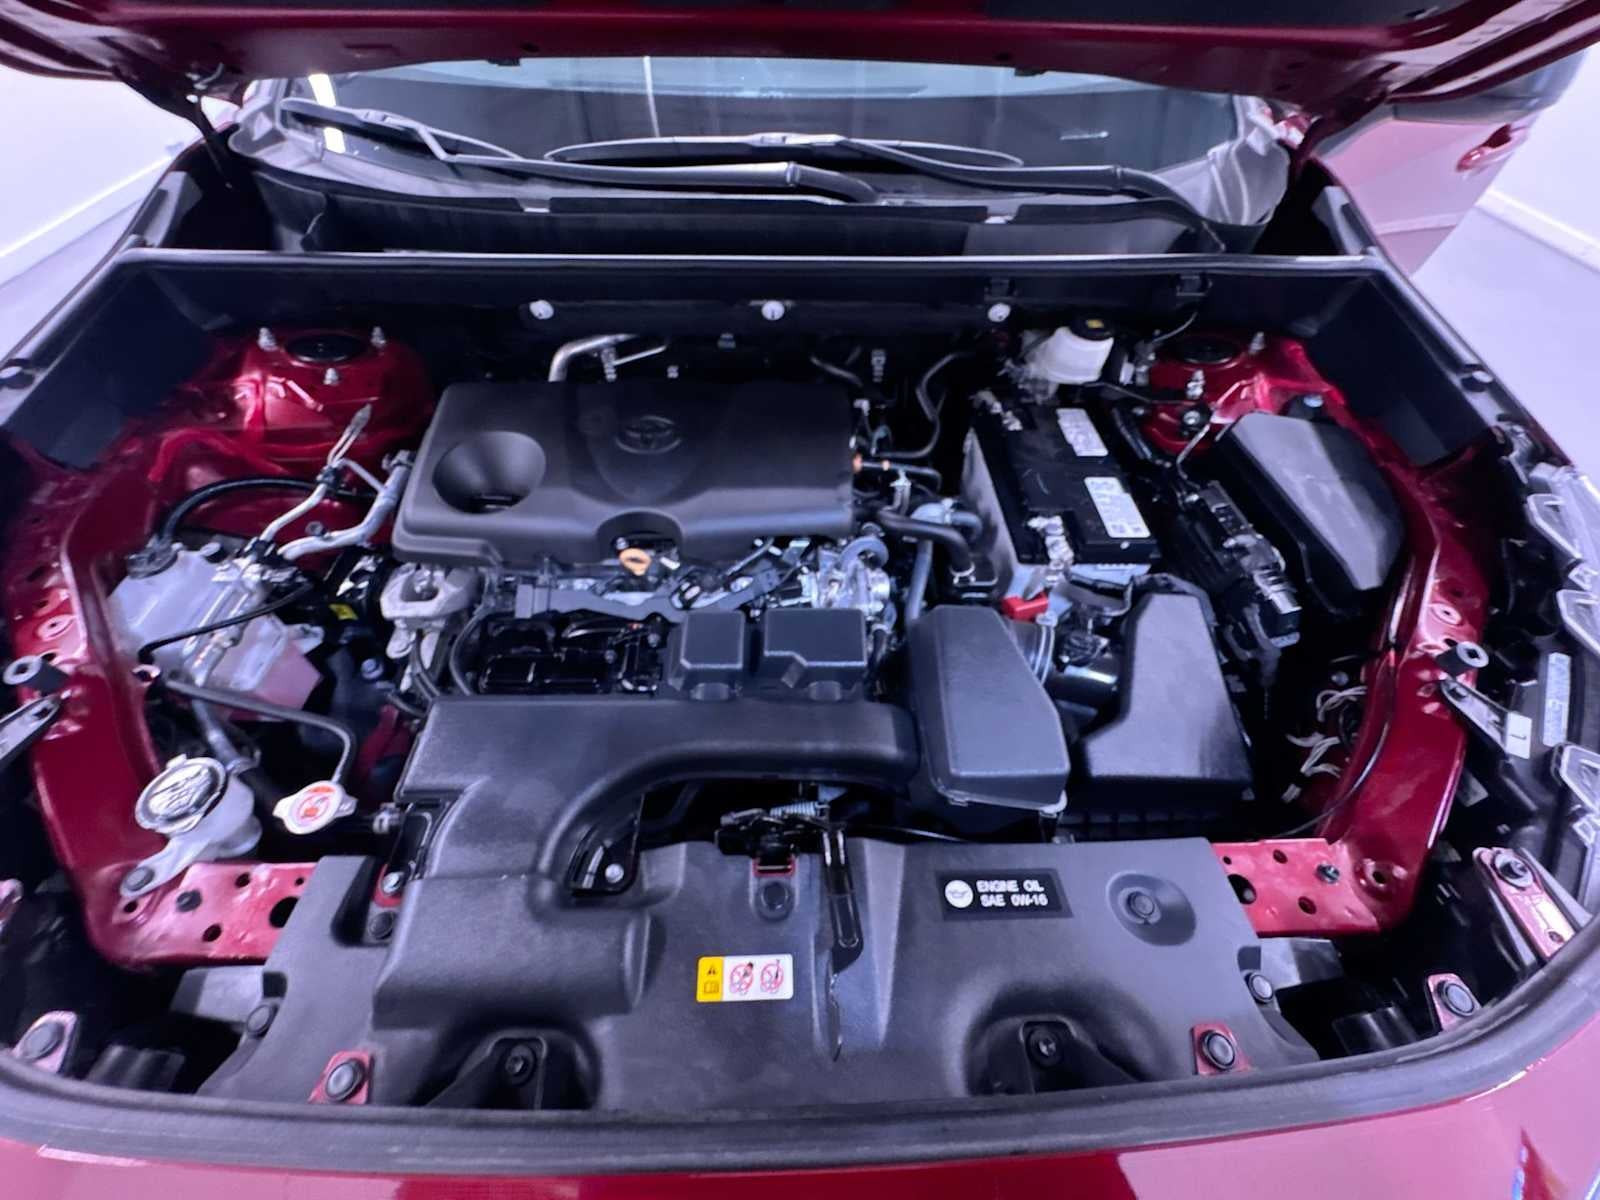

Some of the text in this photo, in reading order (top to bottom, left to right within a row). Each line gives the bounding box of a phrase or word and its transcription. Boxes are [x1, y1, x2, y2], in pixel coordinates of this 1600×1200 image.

[976, 879, 1045, 892] ENGINE OIL
[980, 894, 1006, 907] SAE
